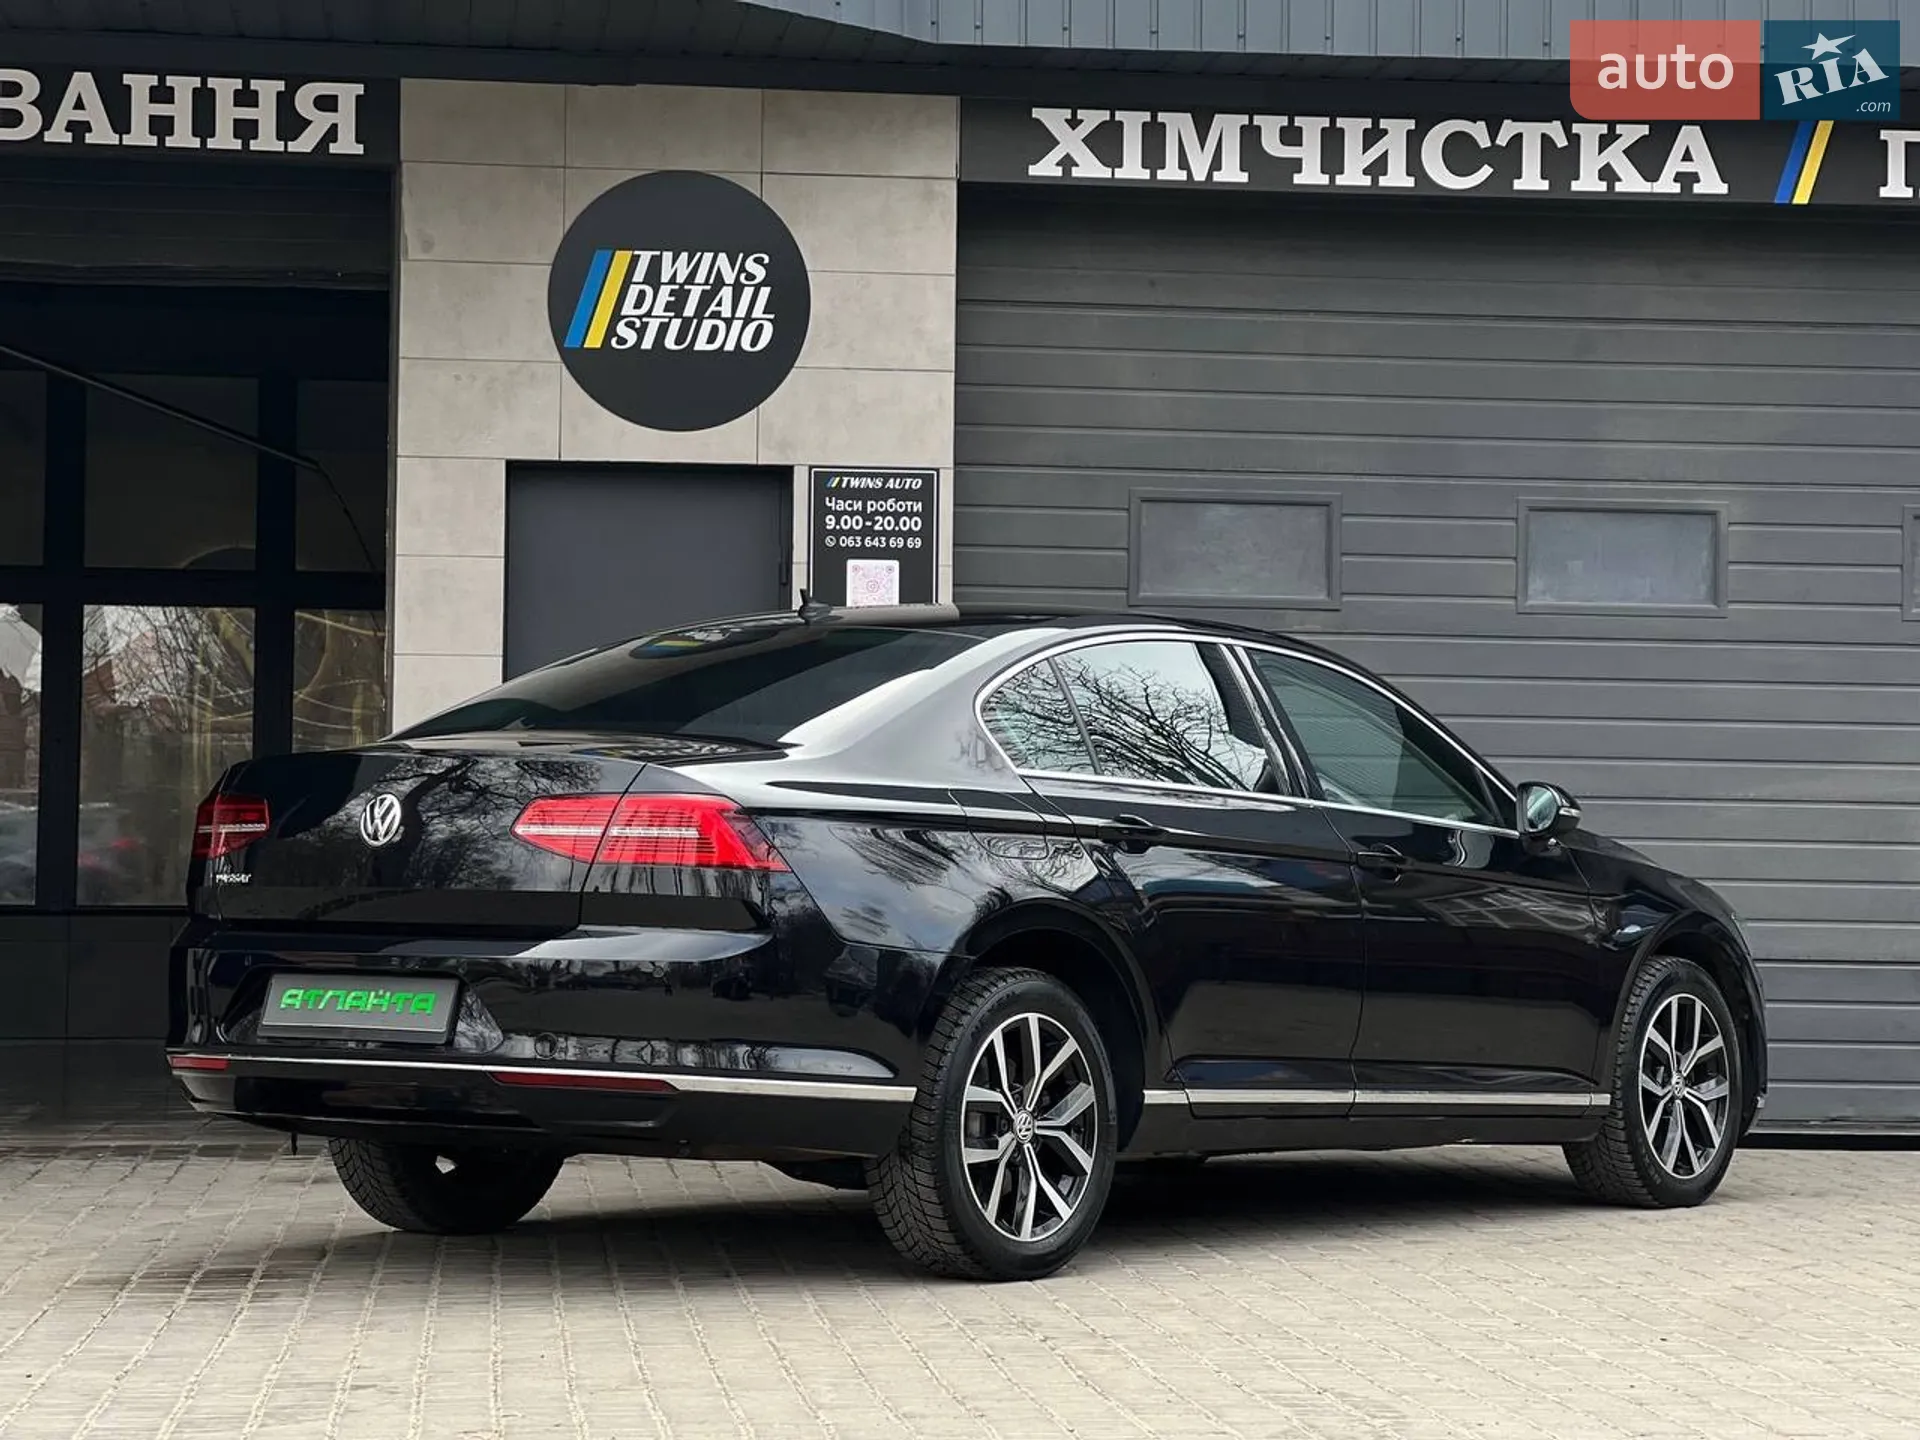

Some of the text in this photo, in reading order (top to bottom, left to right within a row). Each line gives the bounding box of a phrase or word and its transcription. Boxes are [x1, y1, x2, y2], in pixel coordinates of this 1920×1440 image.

[0, 68, 365, 155] ВАННЯ
[1028, 107, 1729, 195] ХІМЧИСТКА
[631, 250, 770, 285] TWINS
[620, 284, 775, 319] DETAIL
[610, 317, 774, 352] STUDIO
[841, 476, 922, 490] TWINS AUTO
[825, 496, 922, 514] Часи роботи
[840, 535, 922, 549] 063 643 69 69
